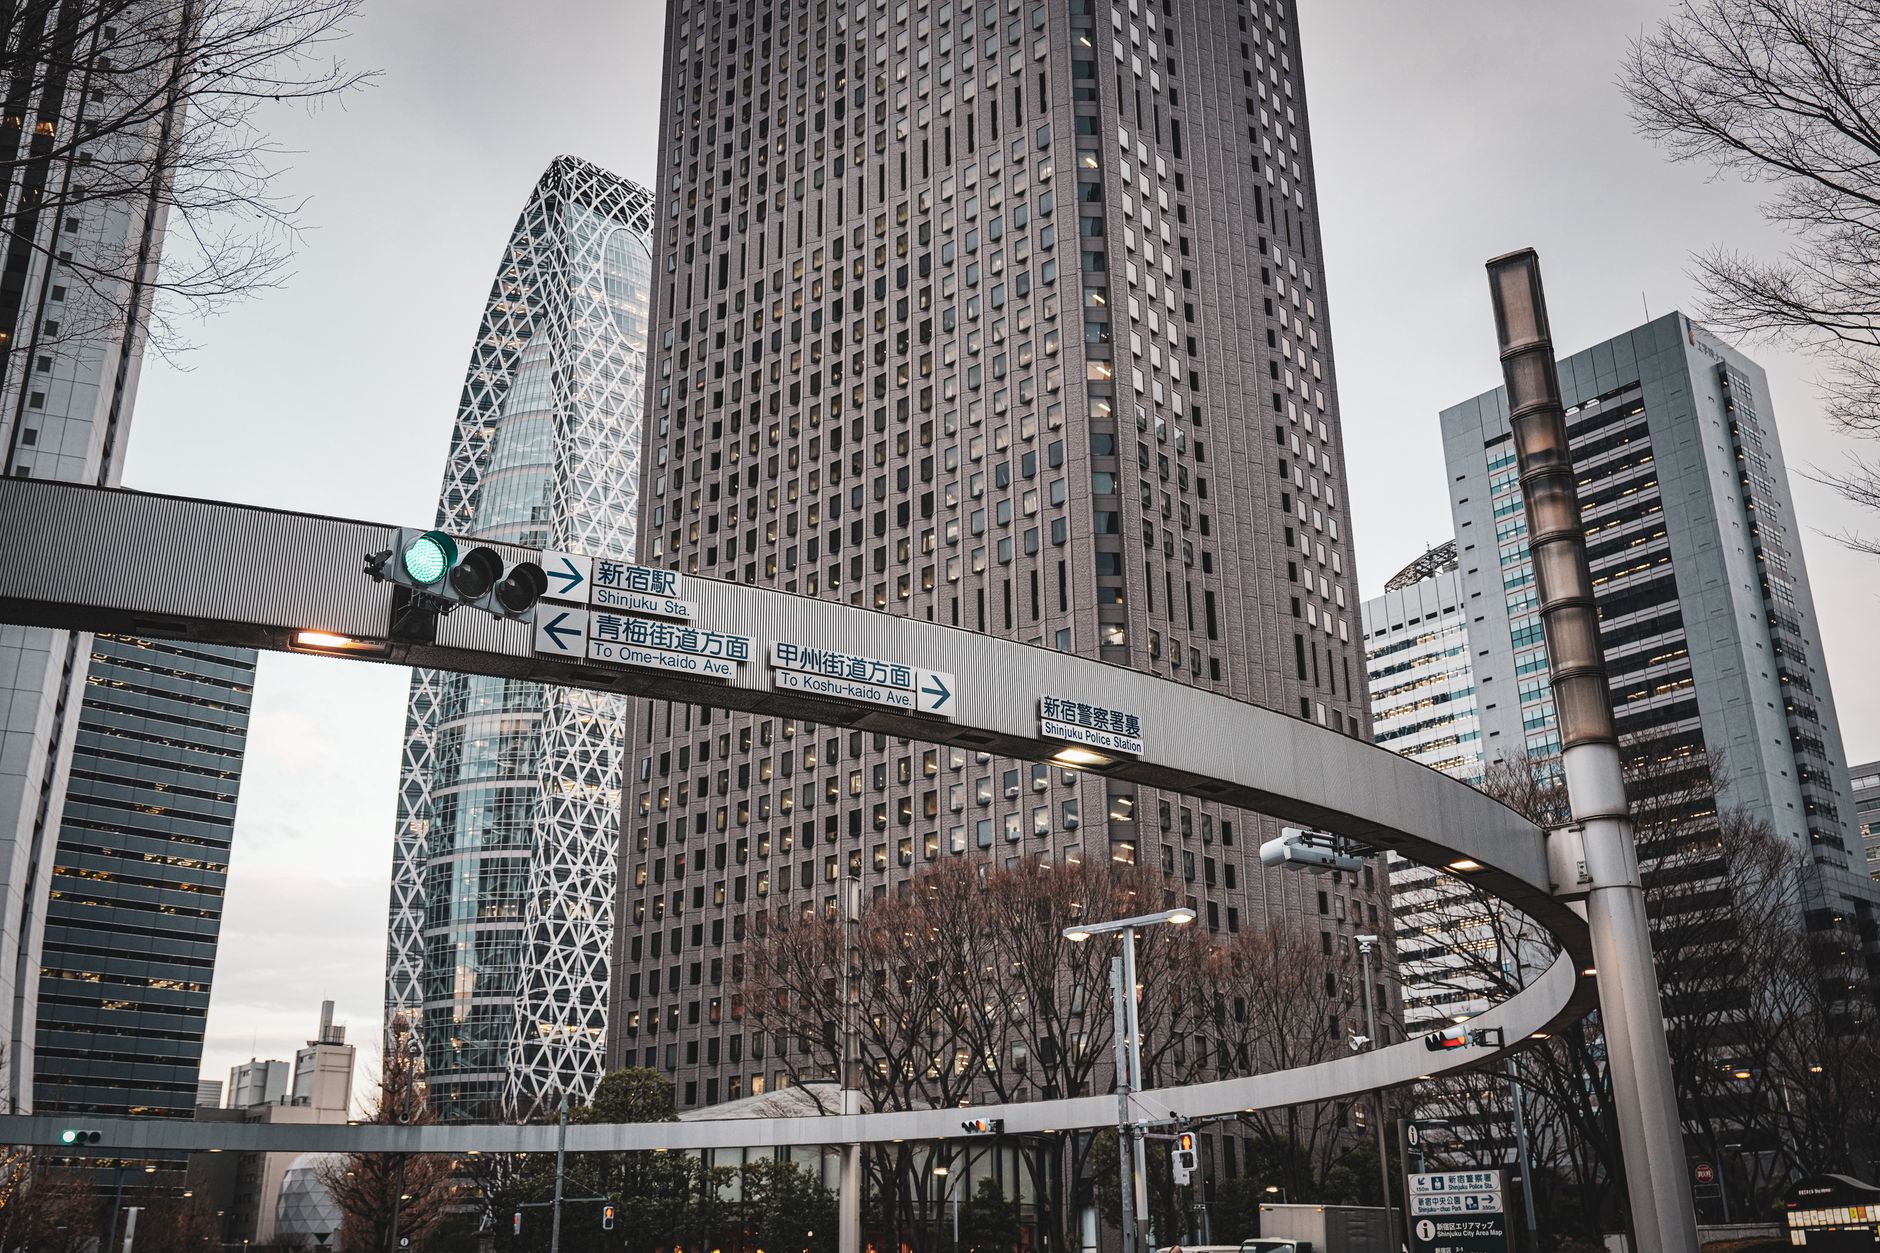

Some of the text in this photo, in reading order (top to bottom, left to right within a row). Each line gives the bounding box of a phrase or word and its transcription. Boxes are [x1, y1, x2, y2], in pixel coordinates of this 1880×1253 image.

[598, 560, 677, 596] 新宿駅
[597, 589, 690, 617] Shinjuku Sta.
[596, 614, 749, 660] 青梅街道方面
[594, 643, 732, 676] To Ome-kaido Ave.
[777, 642, 911, 688] 甲州街道方面
[781, 672, 912, 706] To Koshu-kaido Ave.
[1043, 695, 1141, 738] 新宿警察署裏
[1045, 721, 1142, 752] Shinjuku Police Station
[1436, 1220, 1495, 1231] 新宿区エリアマップ
[1437, 1230, 1462, 1238] Shinjuku
[1462, 1230, 1474, 1238] City
[1489, 1229, 1503, 1237] Map
